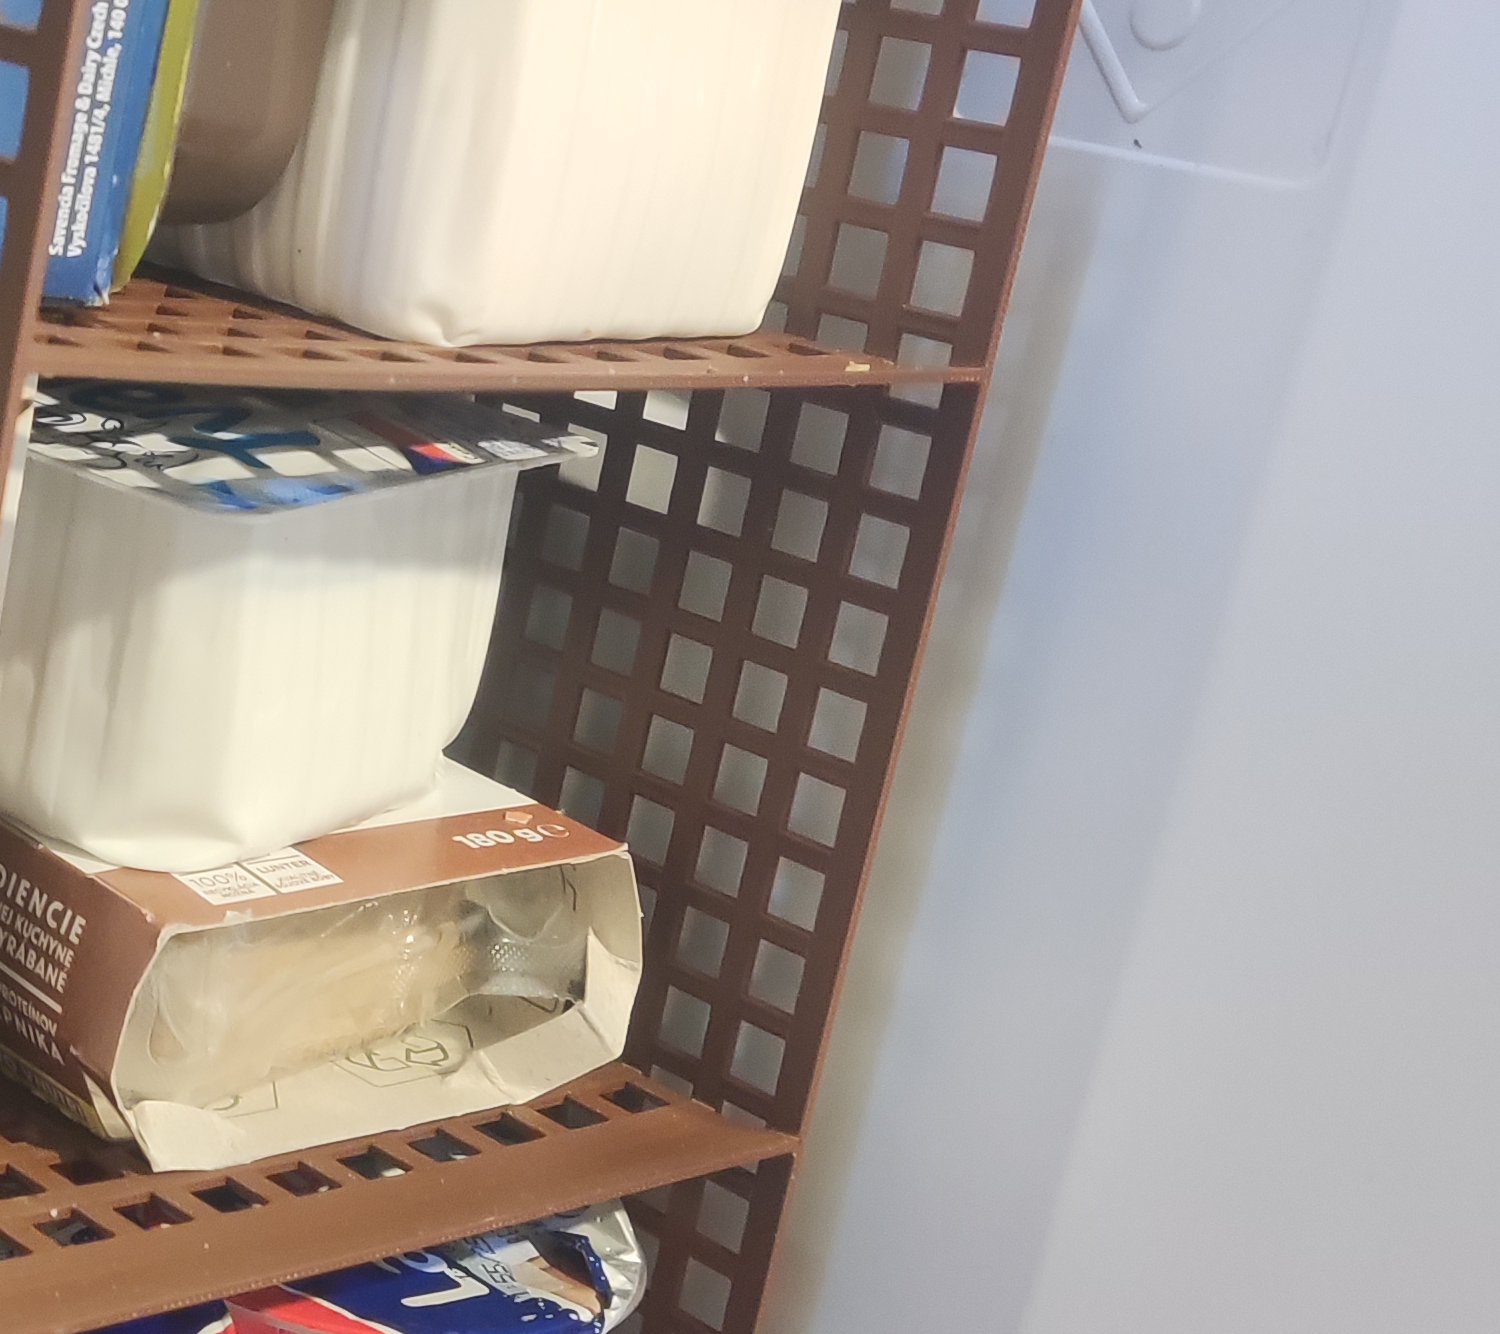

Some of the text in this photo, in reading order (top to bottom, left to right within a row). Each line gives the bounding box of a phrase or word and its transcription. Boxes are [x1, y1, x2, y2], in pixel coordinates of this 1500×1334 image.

[452, 830, 516, 849] 180
[189, 870, 248, 888] 100%
[14, 917, 75, 968] KUCHYNE
